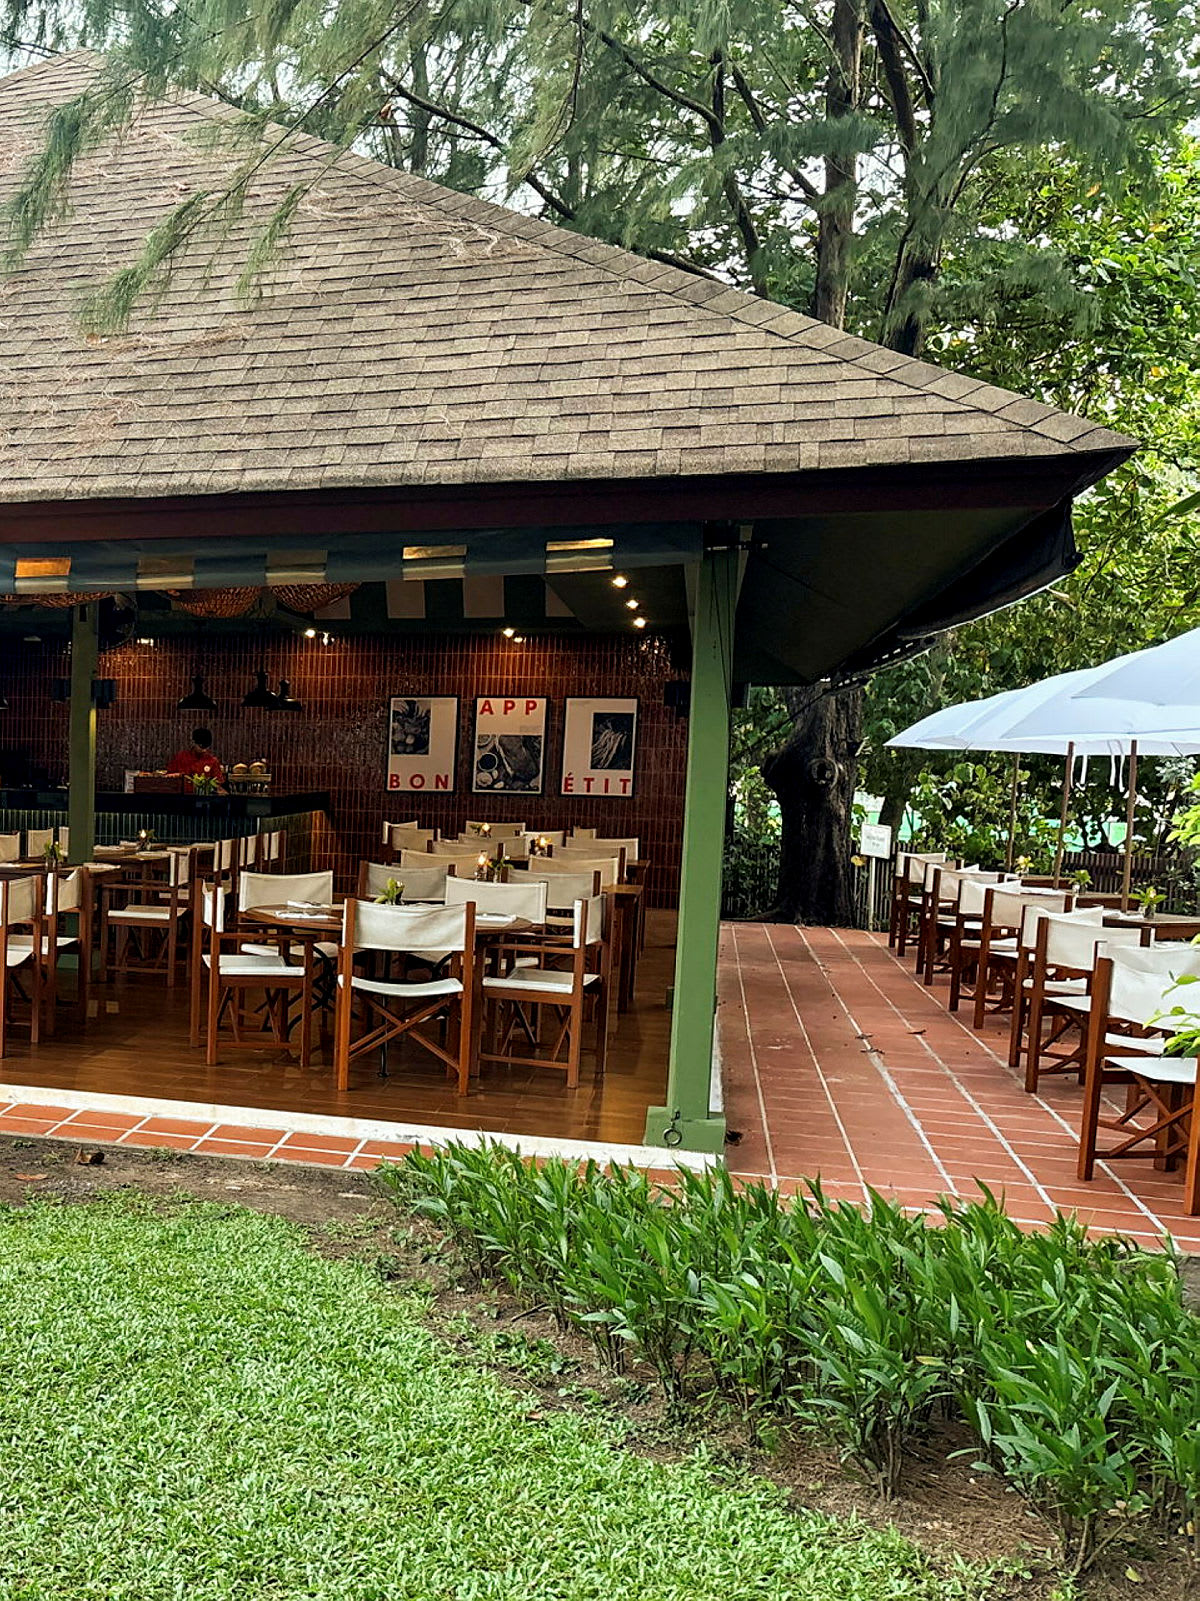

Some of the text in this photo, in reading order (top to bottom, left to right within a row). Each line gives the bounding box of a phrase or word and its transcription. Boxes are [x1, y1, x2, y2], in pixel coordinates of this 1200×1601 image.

[480, 700, 537, 715] APP
[389, 774, 449, 789] BON
[563, 773, 631, 793] ÉTIT
